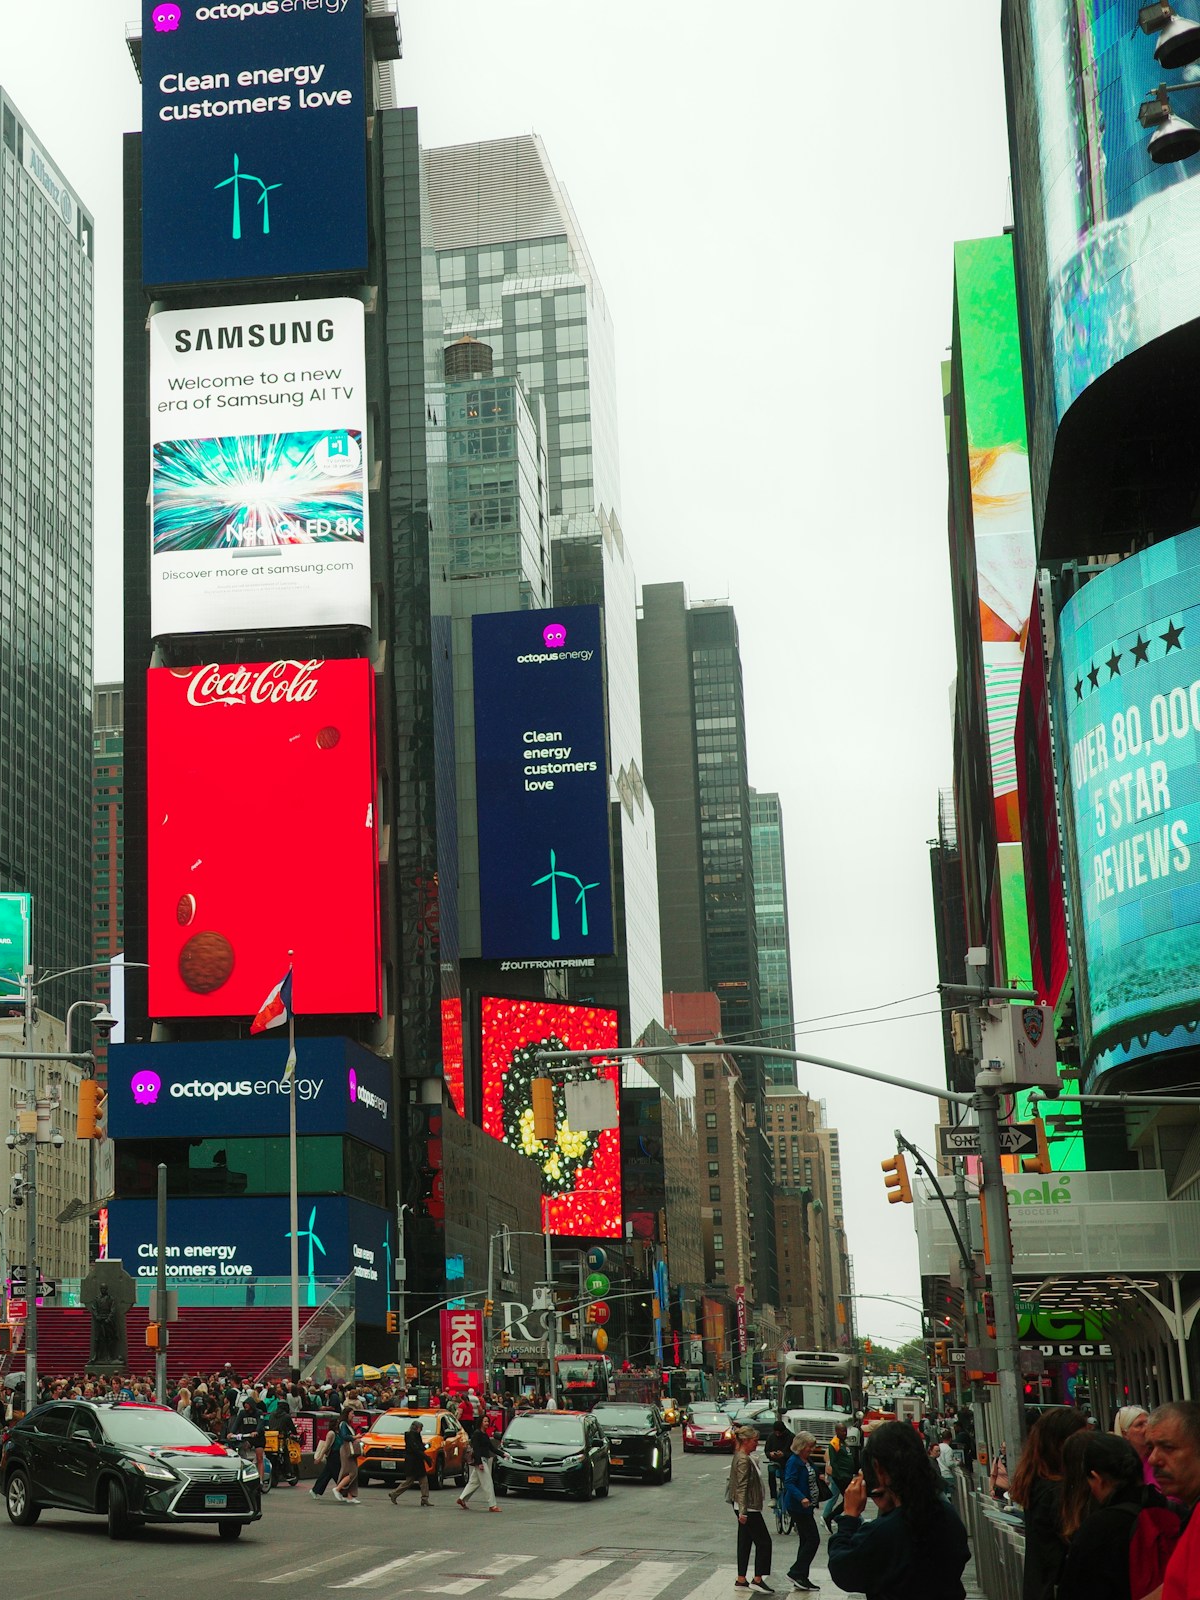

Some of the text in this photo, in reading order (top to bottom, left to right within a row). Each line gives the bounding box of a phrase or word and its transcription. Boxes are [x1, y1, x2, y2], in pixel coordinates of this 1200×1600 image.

[159, 64, 325, 93] Clean energy
[159, 89, 352, 121] customers love
[29, 147, 61, 203] Allianz
[175, 319, 334, 353] SAMSUNG
[168, 368, 342, 390] Welcome to a new
[157, 387, 354, 412] era of Samsung AI TV
[226, 517, 361, 542] Neo QLED 8K
[162, 562, 354, 580] Discover more at samsung.com
[523, 730, 562, 743] Clean
[524, 746, 572, 761] energy
[1074, 722, 1108, 790] OVER
[524, 759, 597, 775] customers
[525, 779, 554, 791] love
[1095, 760, 1171, 837] 5 STAR
[1093, 819, 1191, 903] REVIEWS
[501, 958, 595, 971] #OUTFRONTPRIME
[1017, 1208, 1060, 1216] SOCCER
[184, 1245, 237, 1260] energy
[588, 1255, 597, 1264] m
[220, 1262, 252, 1276] love
[592, 1280, 603, 1289] m
[1015, 1302, 1035, 1312] quity
[451, 1314, 477, 1368] tkts
